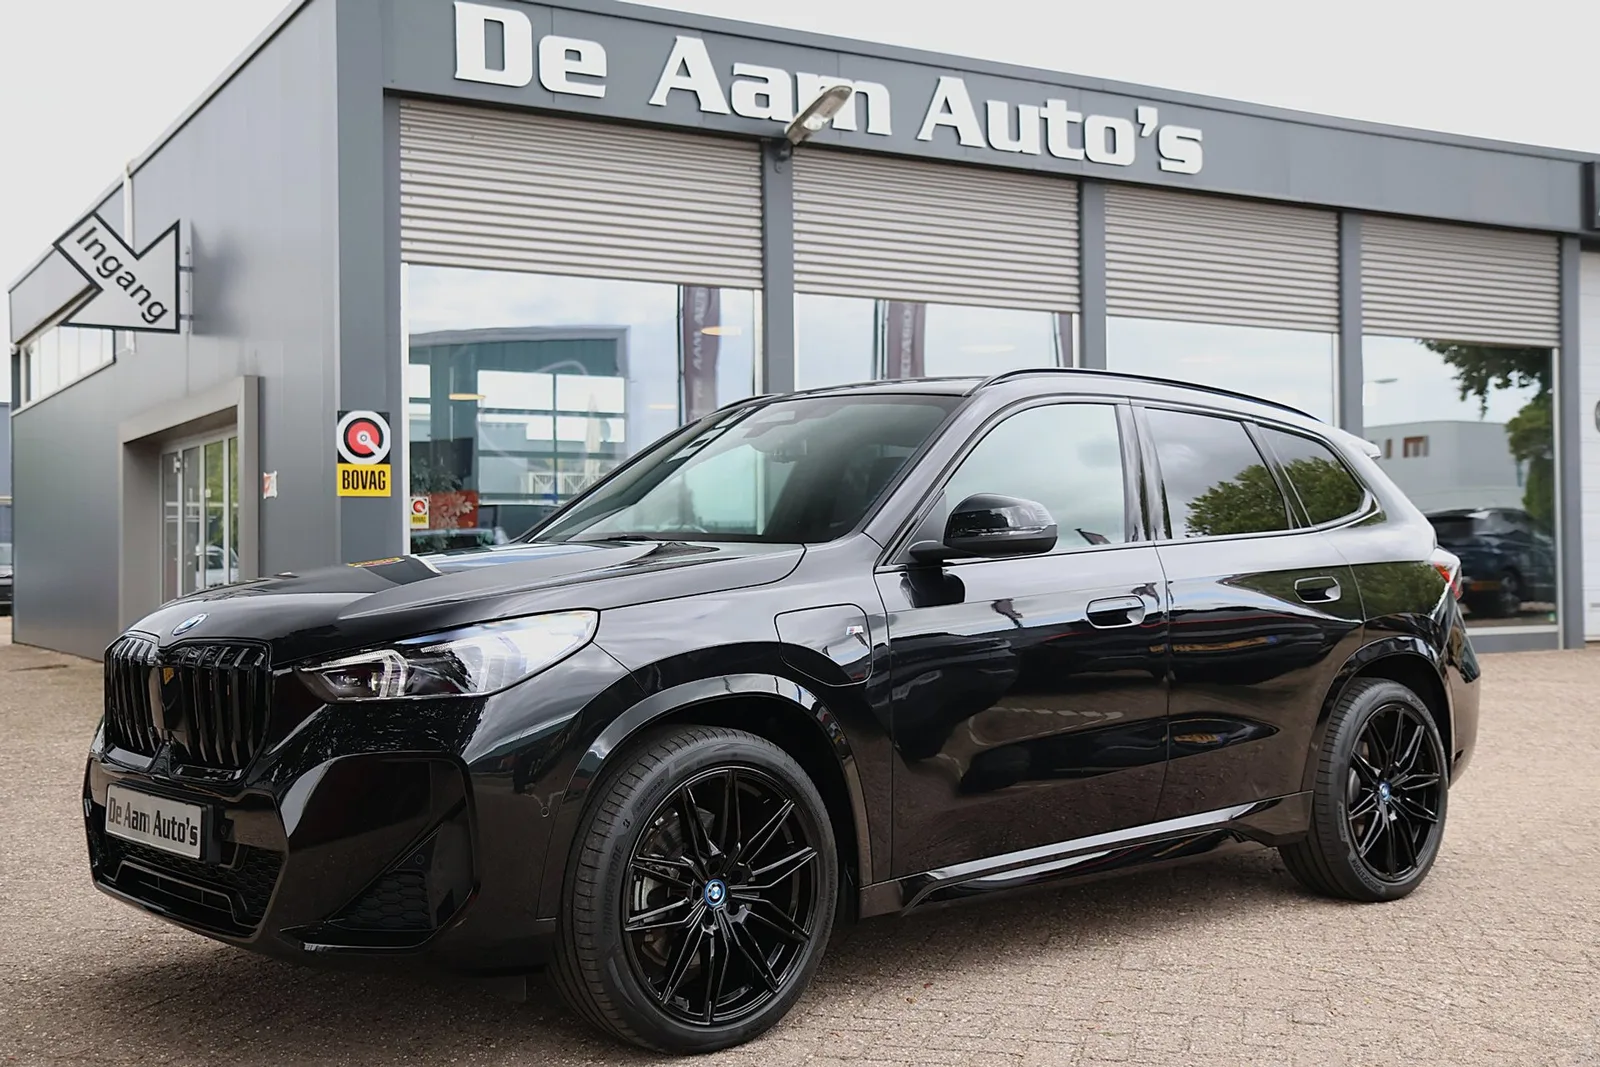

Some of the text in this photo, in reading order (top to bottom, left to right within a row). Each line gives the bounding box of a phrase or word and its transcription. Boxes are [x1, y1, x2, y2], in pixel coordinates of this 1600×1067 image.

[452, 1, 1204, 175] De Aam Auto's
[76, 226, 168, 324] Ingang
[342, 469, 386, 491] BOVAG
[108, 797, 198, 846] De Aam Auto's
